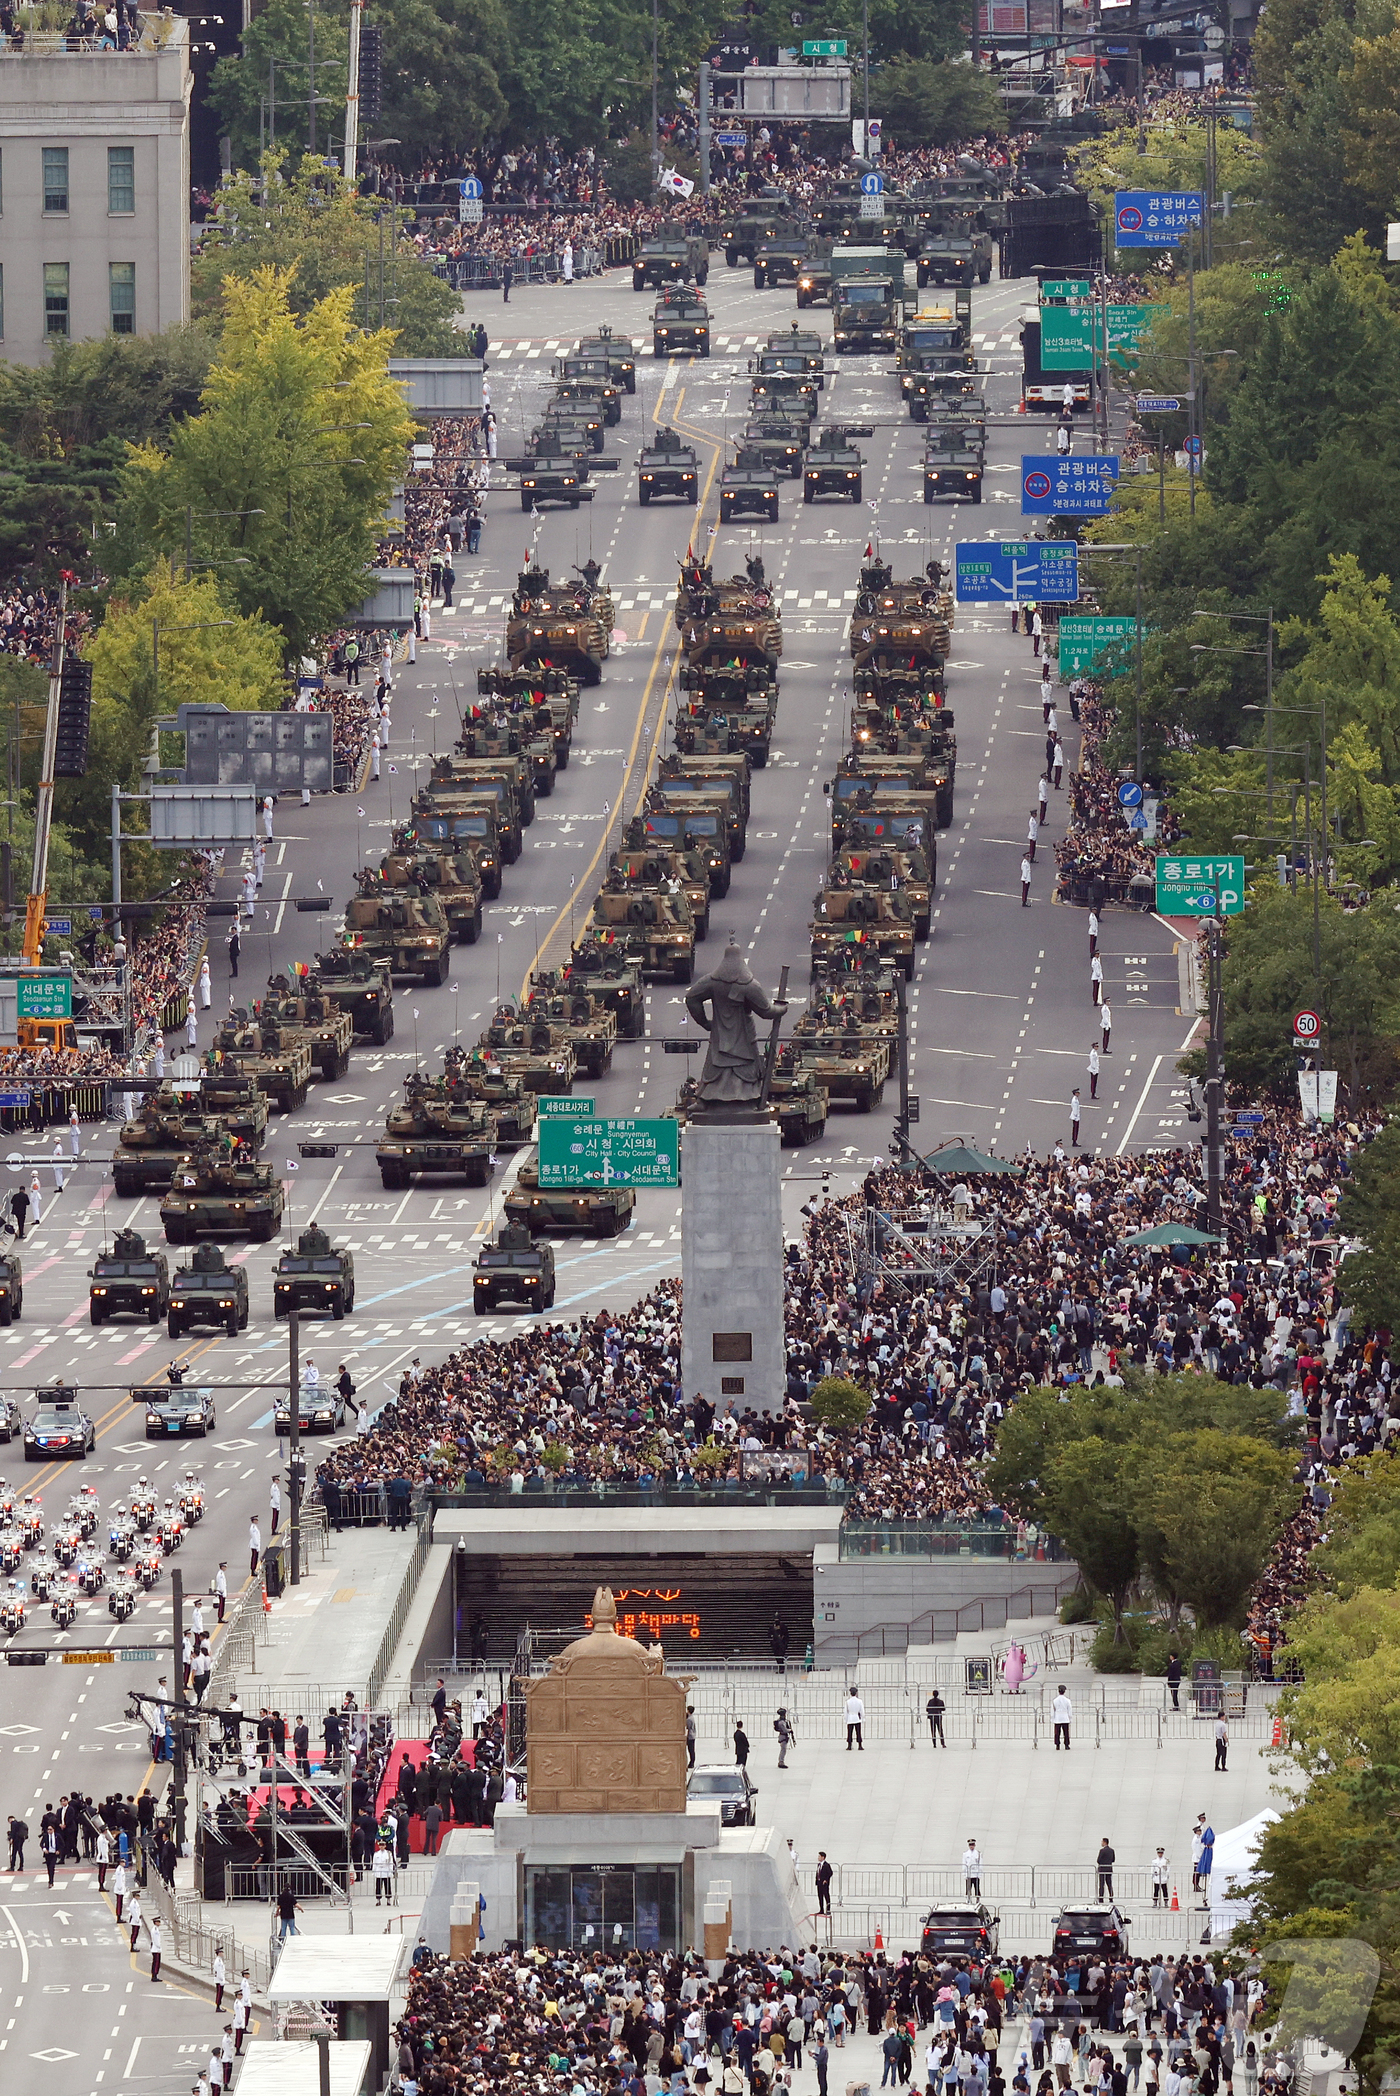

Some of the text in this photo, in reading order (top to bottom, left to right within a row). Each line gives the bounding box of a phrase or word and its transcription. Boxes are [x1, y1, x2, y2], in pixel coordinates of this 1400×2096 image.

[811, 46, 838, 54] 시청
[1147, 197, 1200, 211] 관광버스
[1053, 284, 1079, 295] 시청
[1057, 462, 1113, 476] 관광버스
[1003, 546, 1026, 555] 서울역
[1040, 560, 1073, 569] 서소문로
[963, 575, 987, 584] 소공로
[1096, 624, 1124, 634] 숭례문
[1162, 862, 1235, 880] 종로1가
[1202, 896, 1210, 907] 6
[22, 984, 66, 996] 서대문역
[1299, 1017, 1315, 1032] 50
[545, 1102, 590, 1112] 세종대로사거리
[573, 1124, 603, 1135] 숭례문
[607, 1131, 650, 1139] Sungnyemun
[622, 1138, 657, 1149] 시의회
[541, 1164, 579, 1175] 종로1가
[631, 1164, 671, 1175] 서대문역
[78, 1742, 142, 1752] 50
[42, 1983, 111, 1994] 50
